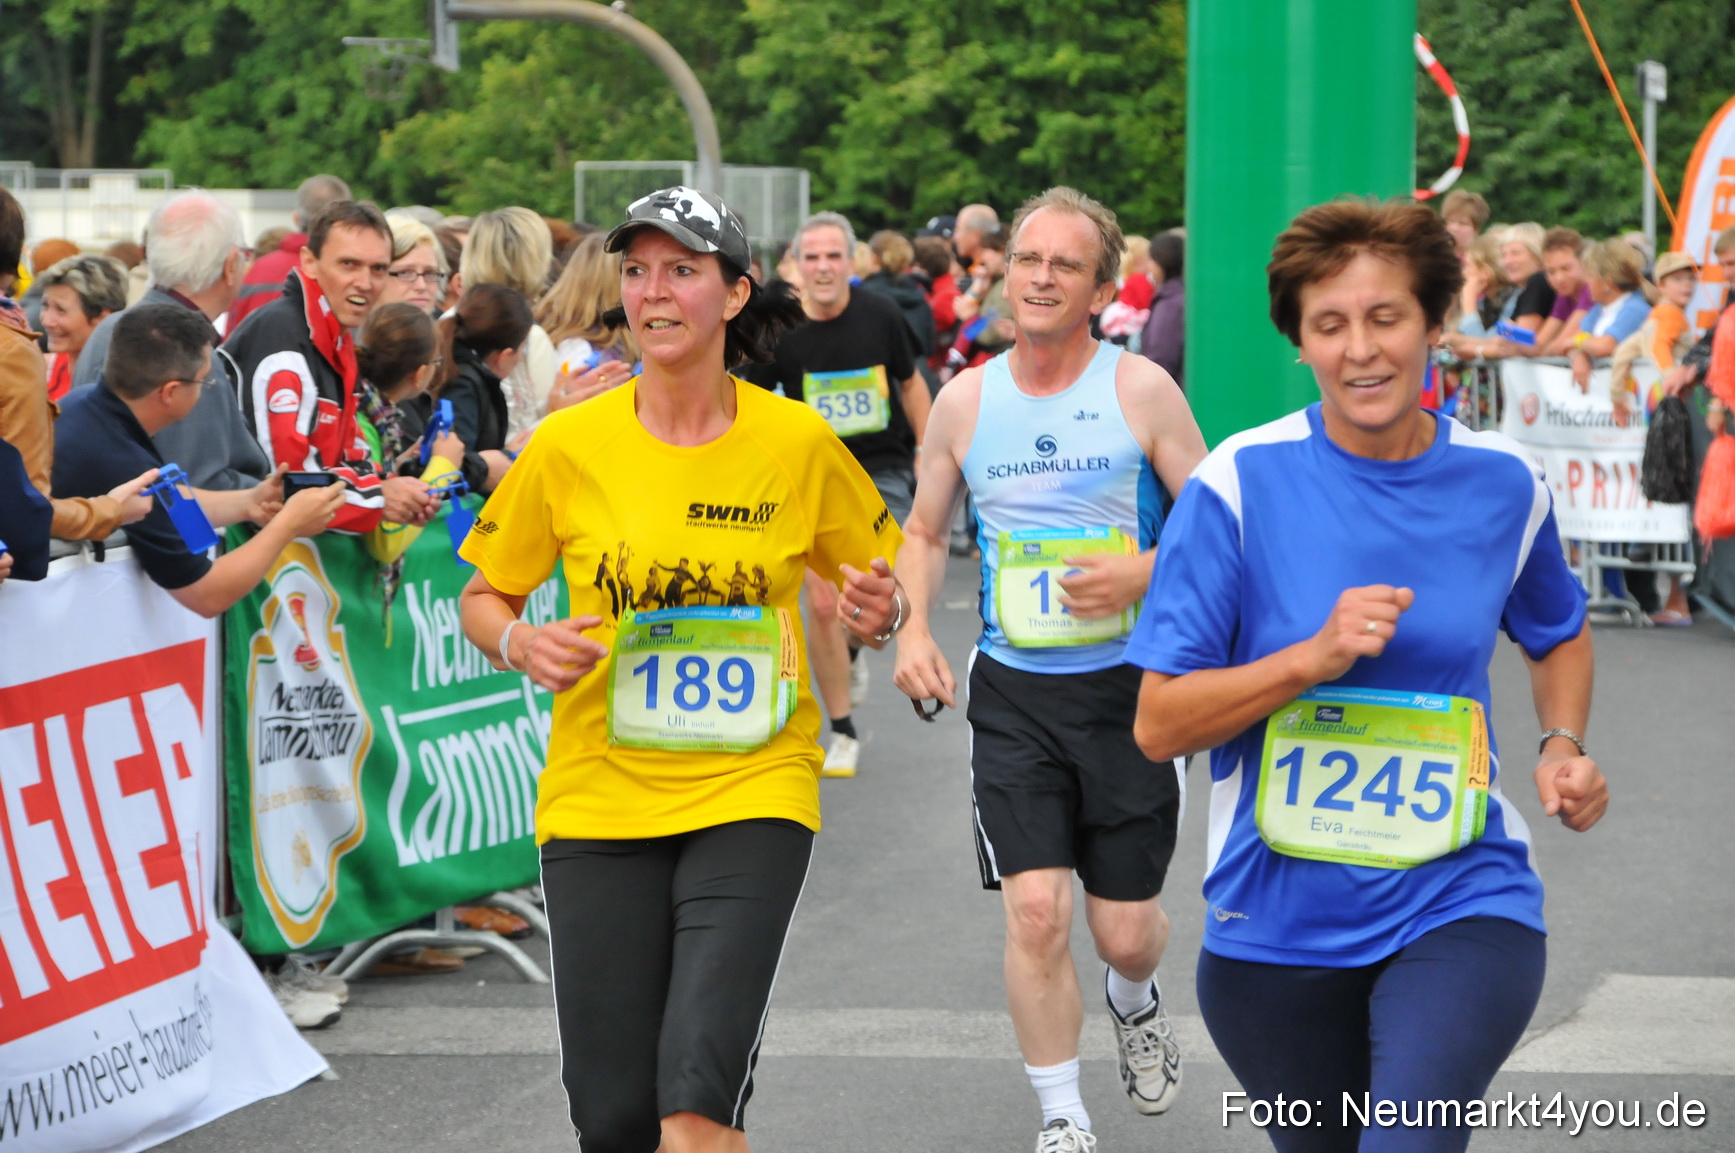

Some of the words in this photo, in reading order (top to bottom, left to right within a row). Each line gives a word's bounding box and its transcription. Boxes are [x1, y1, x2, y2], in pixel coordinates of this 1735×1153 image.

[817, 391, 871, 420] 538
[987, 457, 1111, 480] SCHABMÜLLER
[1031, 480, 1062, 492] TEAM
[687, 502, 751, 523] swn
[686, 520, 729, 530] stadtwerke
[730, 524, 765, 533] neumarkt
[1027, 617, 1073, 629] Thomas
[633, 654, 755, 714] 189
[667, 714, 686, 728] Uli
[1299, 719, 1369, 736] firmenlauf
[1275, 746, 1455, 822] 1245
[1310, 816, 1343, 834] Eva
[1349, 827, 1402, 841] Feichtmeier
